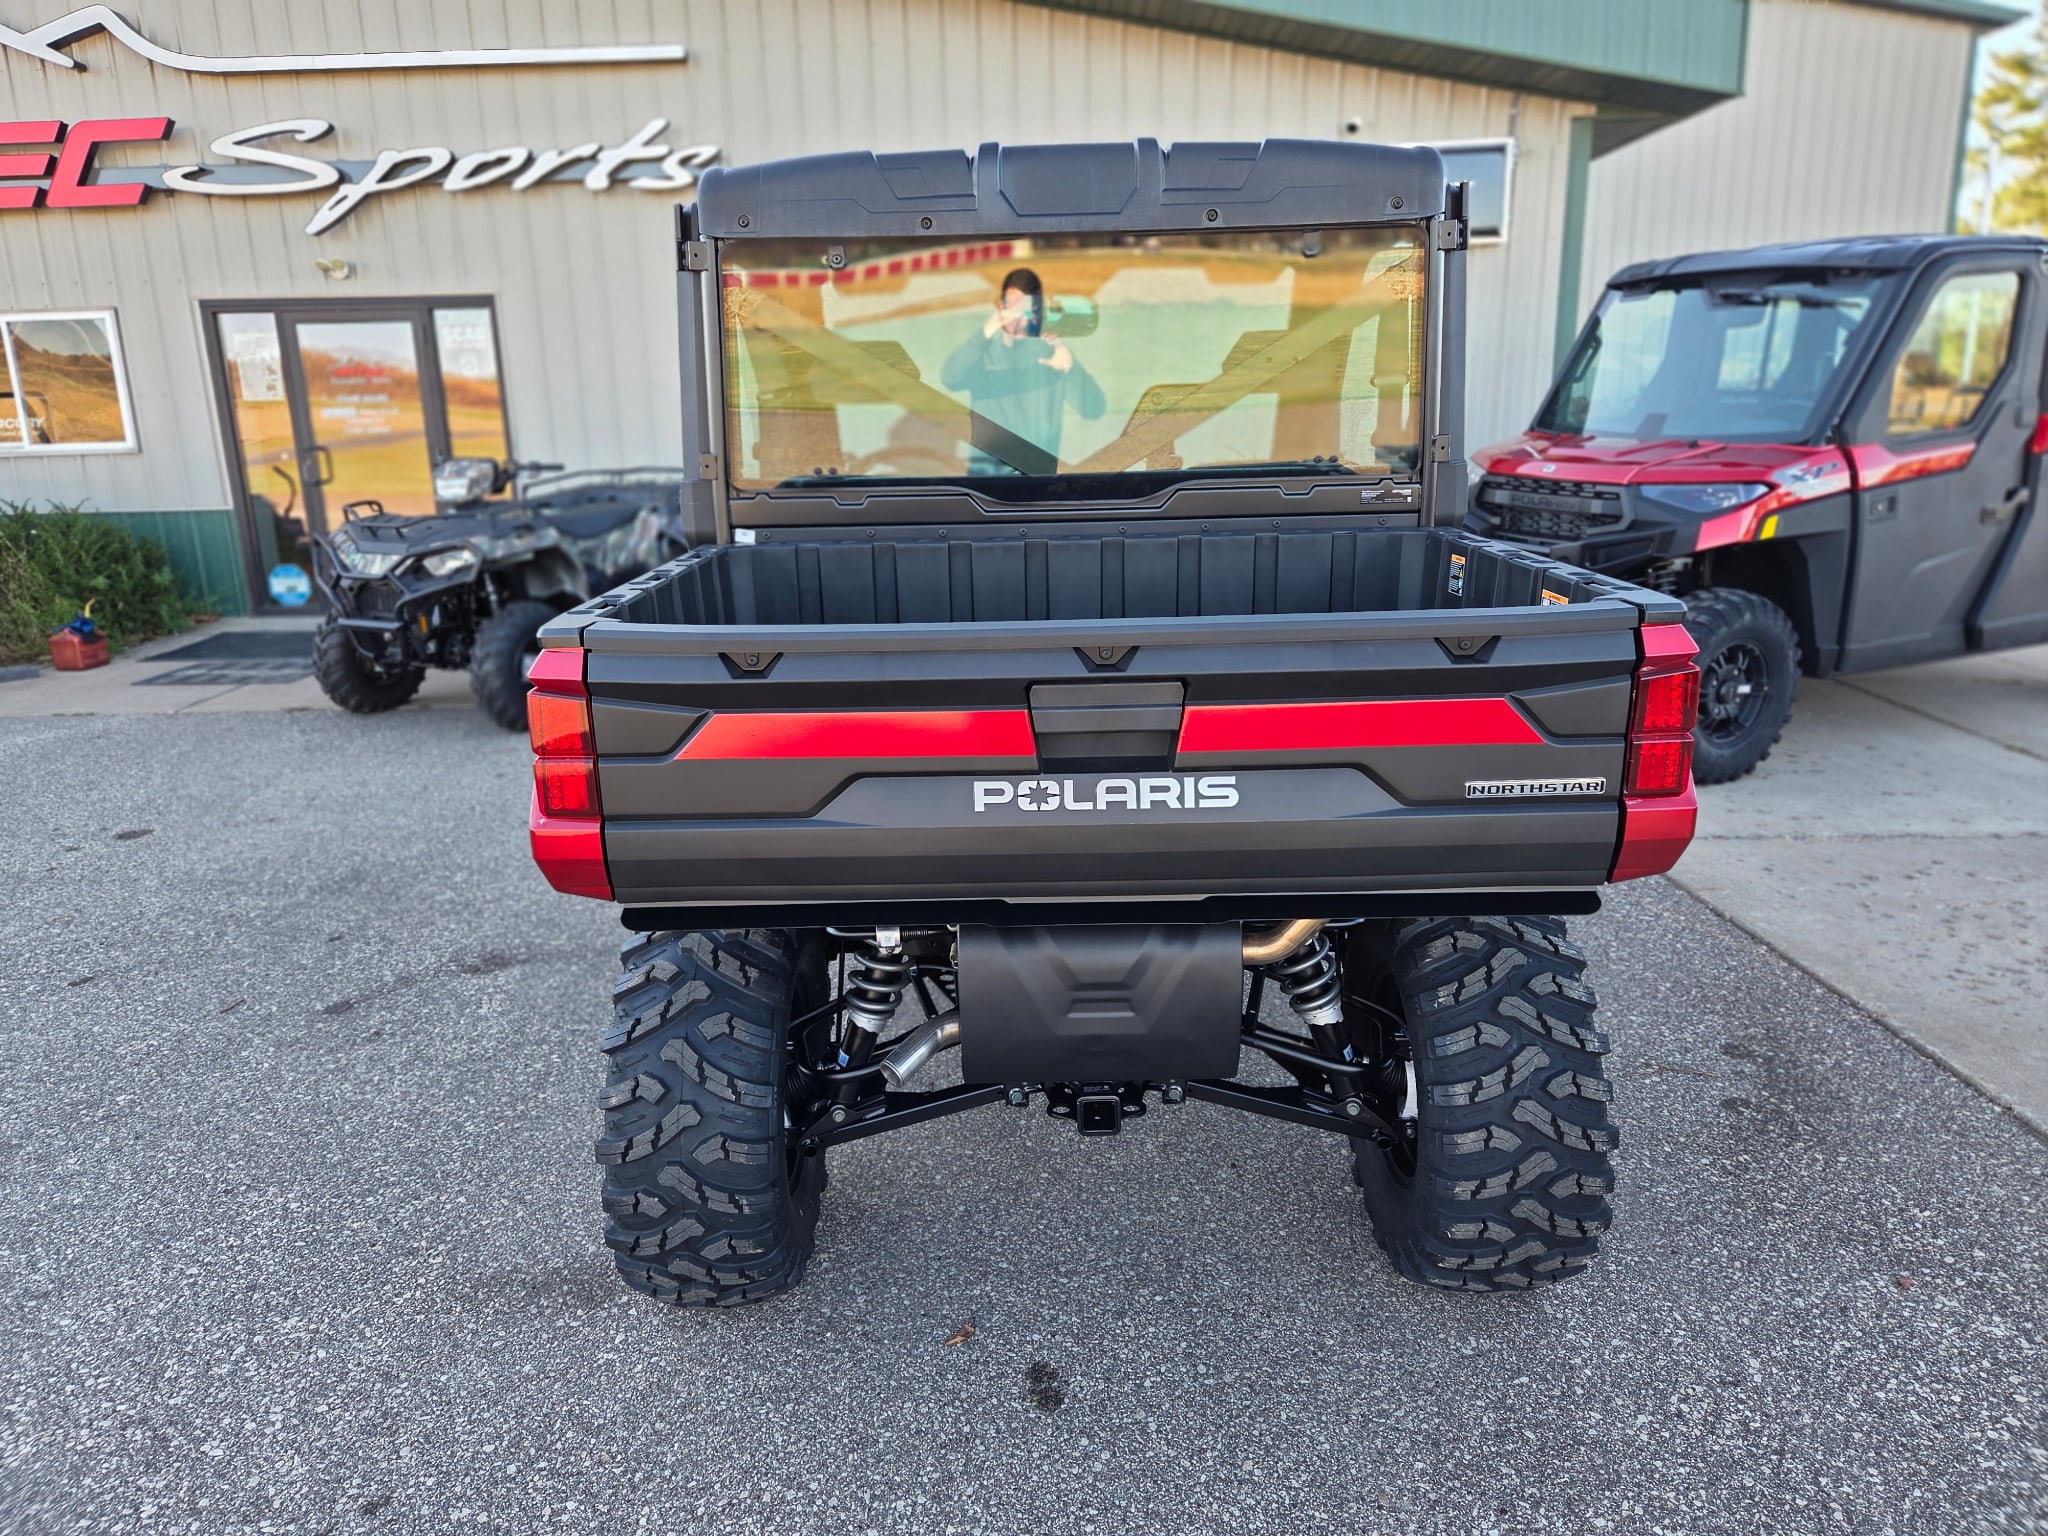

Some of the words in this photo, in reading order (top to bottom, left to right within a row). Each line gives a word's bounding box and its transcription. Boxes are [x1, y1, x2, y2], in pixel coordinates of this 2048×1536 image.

[161, 117, 720, 236] Sports
[973, 776, 1240, 812] POLARIS
[1471, 781, 1600, 795] NORTHSTAR
